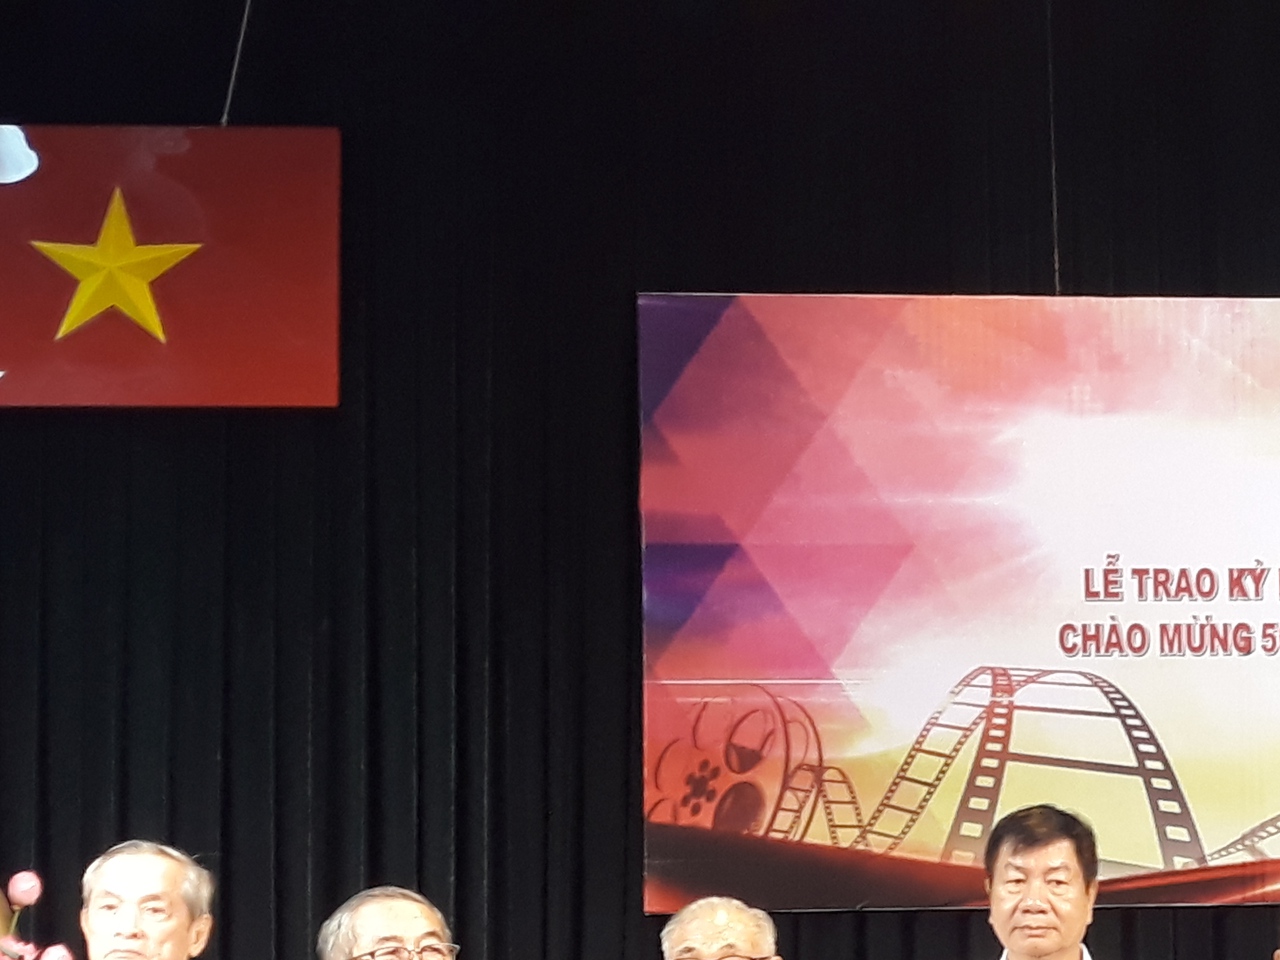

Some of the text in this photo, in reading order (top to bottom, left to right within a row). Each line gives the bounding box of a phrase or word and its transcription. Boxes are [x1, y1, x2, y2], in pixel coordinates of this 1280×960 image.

[1083, 554, 1125, 601] LỄ
[1131, 567, 1219, 601] TRAO
[1228, 559, 1270, 600] KỶ
[1058, 615, 1149, 657] CHÀO
[1159, 614, 1257, 657] MỪNG
